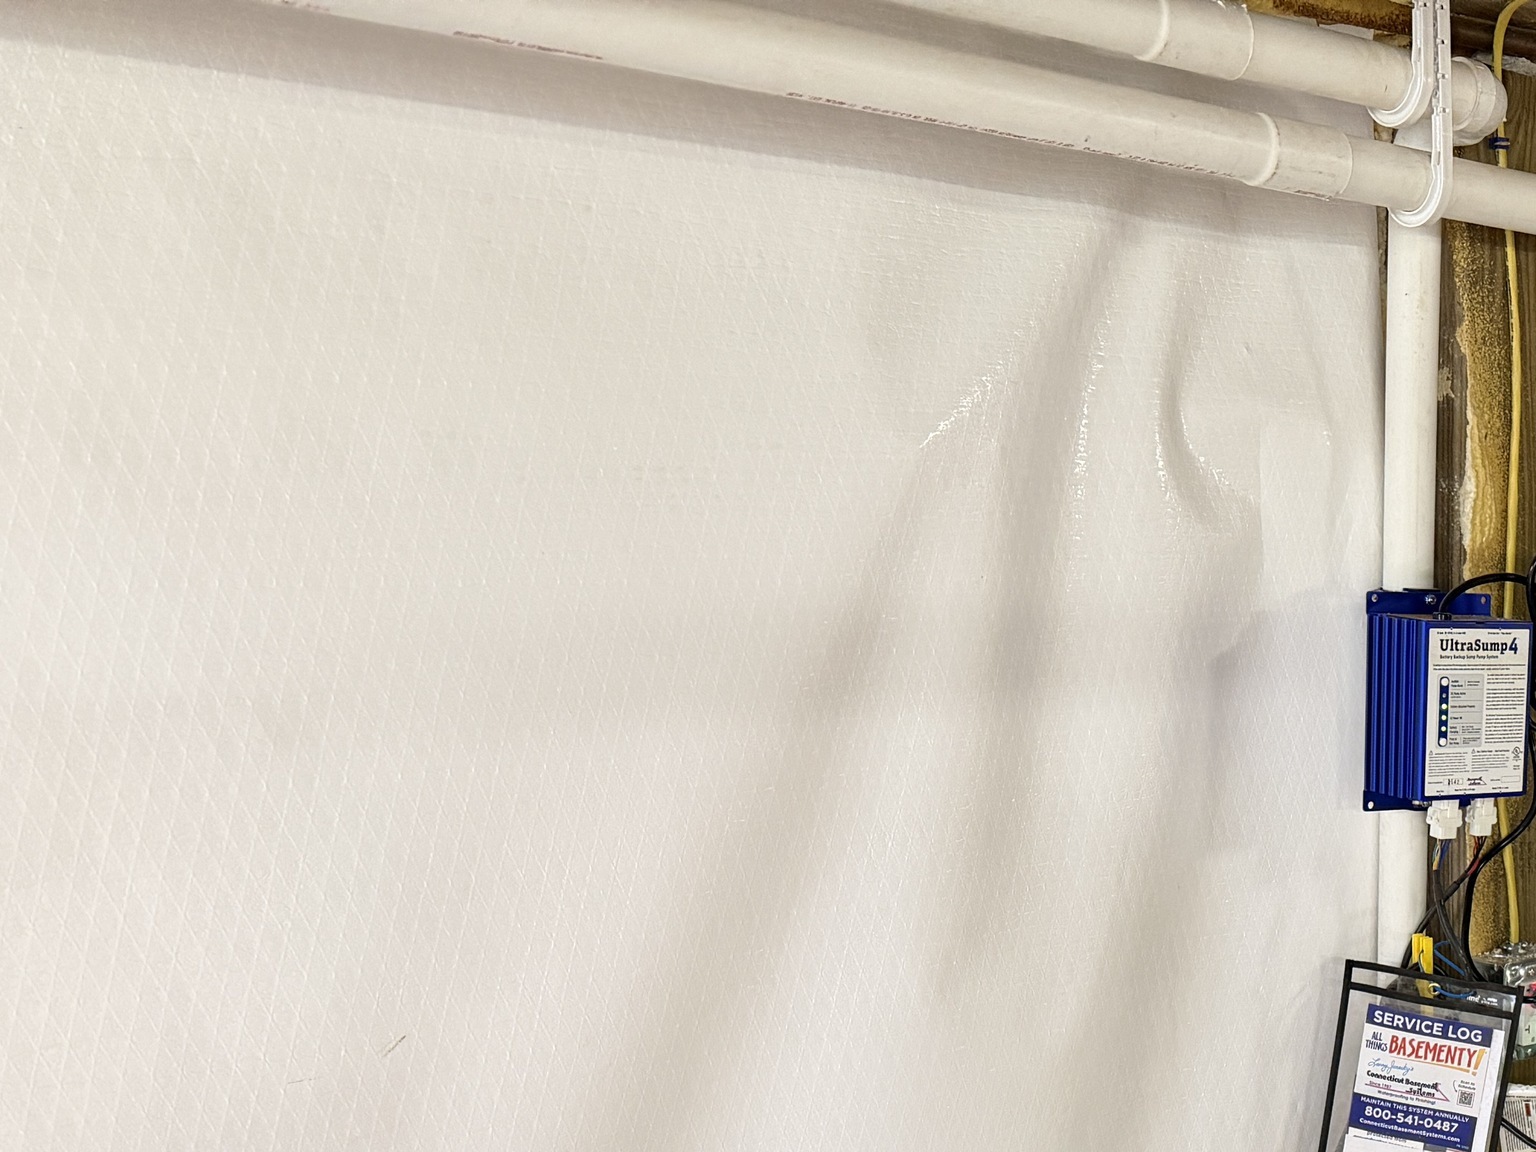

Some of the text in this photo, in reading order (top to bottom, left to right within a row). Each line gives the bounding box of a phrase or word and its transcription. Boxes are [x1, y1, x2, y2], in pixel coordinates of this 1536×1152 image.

[1371, 1031, 1382, 1041] ALL
[1373, 1010, 1482, 1042] SERVICE LOG
[1365, 1039, 1388, 1052] THINGS
[1388, 1034, 1486, 1076] BASEMENTY!
[1366, 1070, 1440, 1092] Connecticut Basement
[1360, 1096, 1470, 1123] MAINTAIN THIS SYSTEM ANNUALLY
[1364, 1105, 1459, 1133] 800-541-0487
[1359, 1118, 1461, 1143] ConnecticutBasementSystems.com
